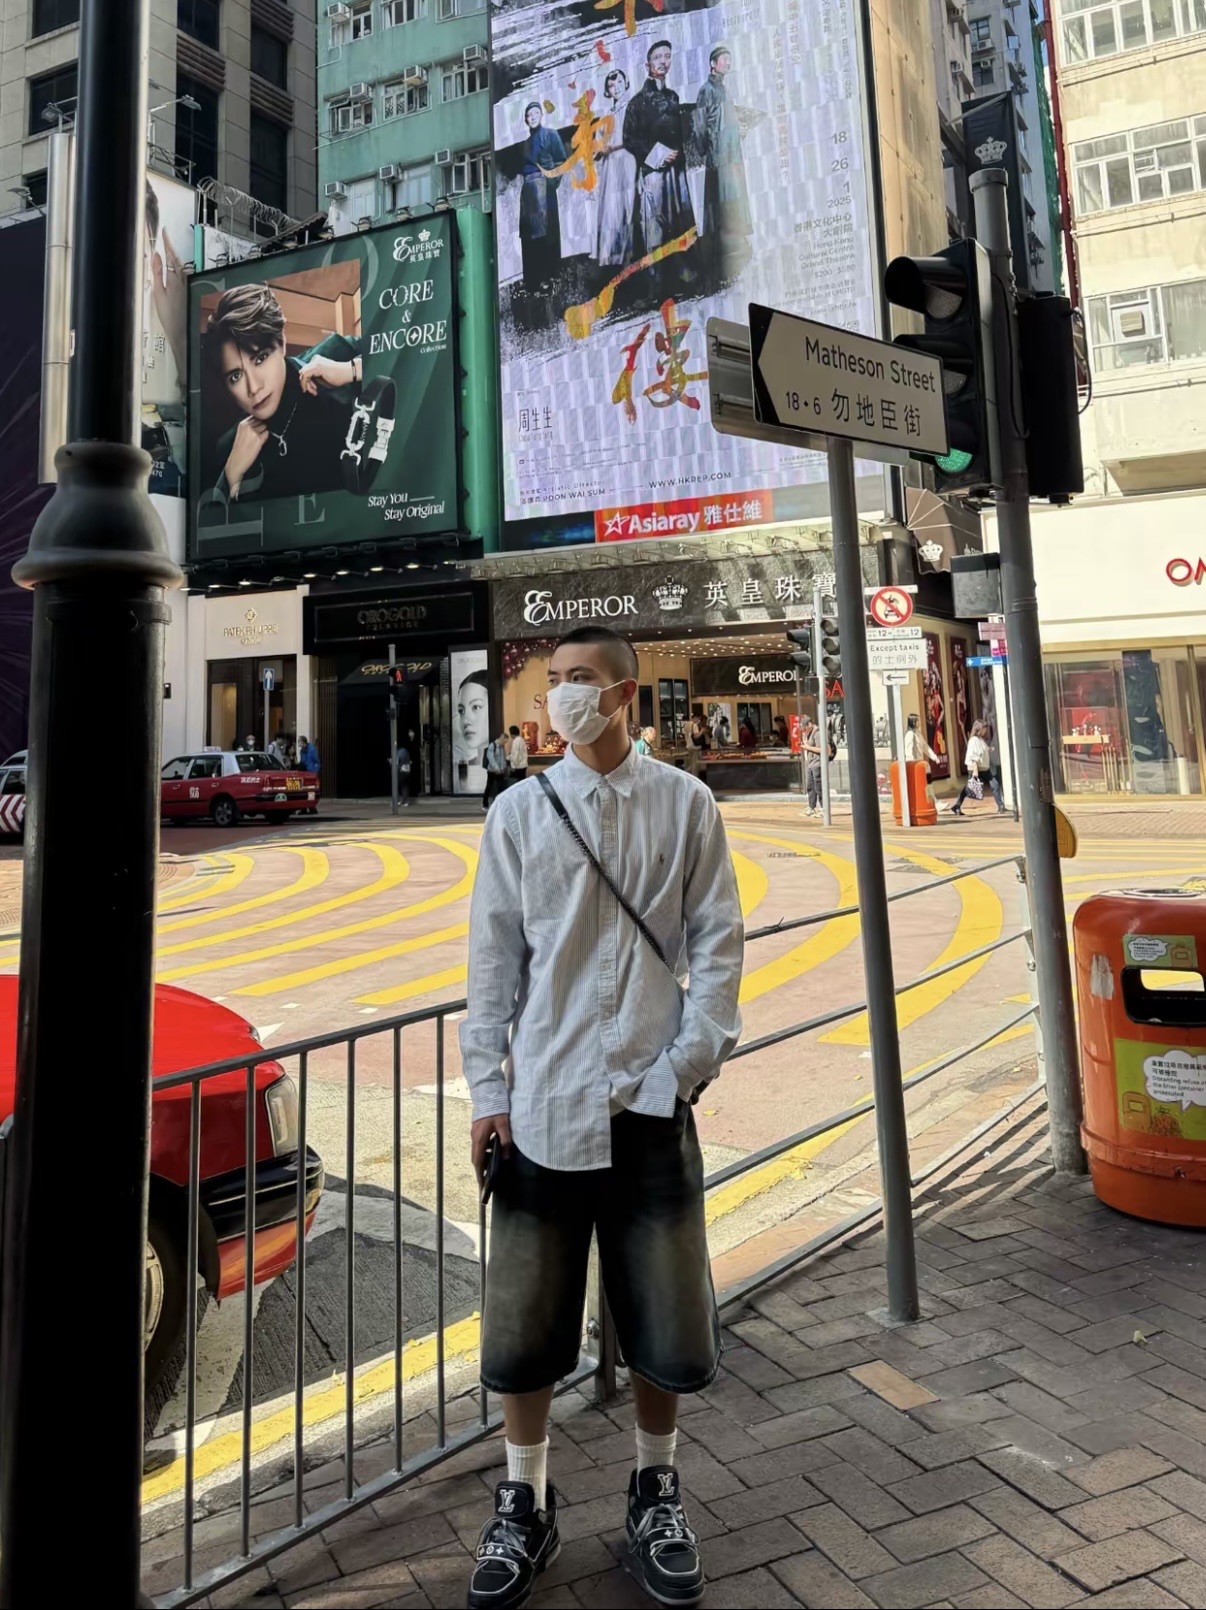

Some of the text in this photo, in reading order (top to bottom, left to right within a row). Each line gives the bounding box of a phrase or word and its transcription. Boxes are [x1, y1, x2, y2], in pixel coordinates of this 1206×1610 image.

[830, 130, 847, 144] 18
[831, 157, 849, 172] 26
[827, 195, 852, 208] 2025
[392, 236, 444, 262] EMPEROR
[379, 279, 434, 309] CORE
[401, 309, 412, 323] &
[369, 320, 447, 355] ENCORE
[805, 336, 936, 393] Matheson Street
[518, 406, 552, 432] 周生生
[831, 388, 921, 437] 勿地臣街
[368, 493, 408, 508] Stay You
[384, 501, 445, 521] Stay Original
[628, 500, 763, 533] Asiaray 雅仕維
[523, 572, 837, 626] EMPEROR 英皇珠寶
[899, 643, 919, 651] taxis
[361, 662, 432, 673] OROOLD
[872, 655, 917, 665] 的士例外
